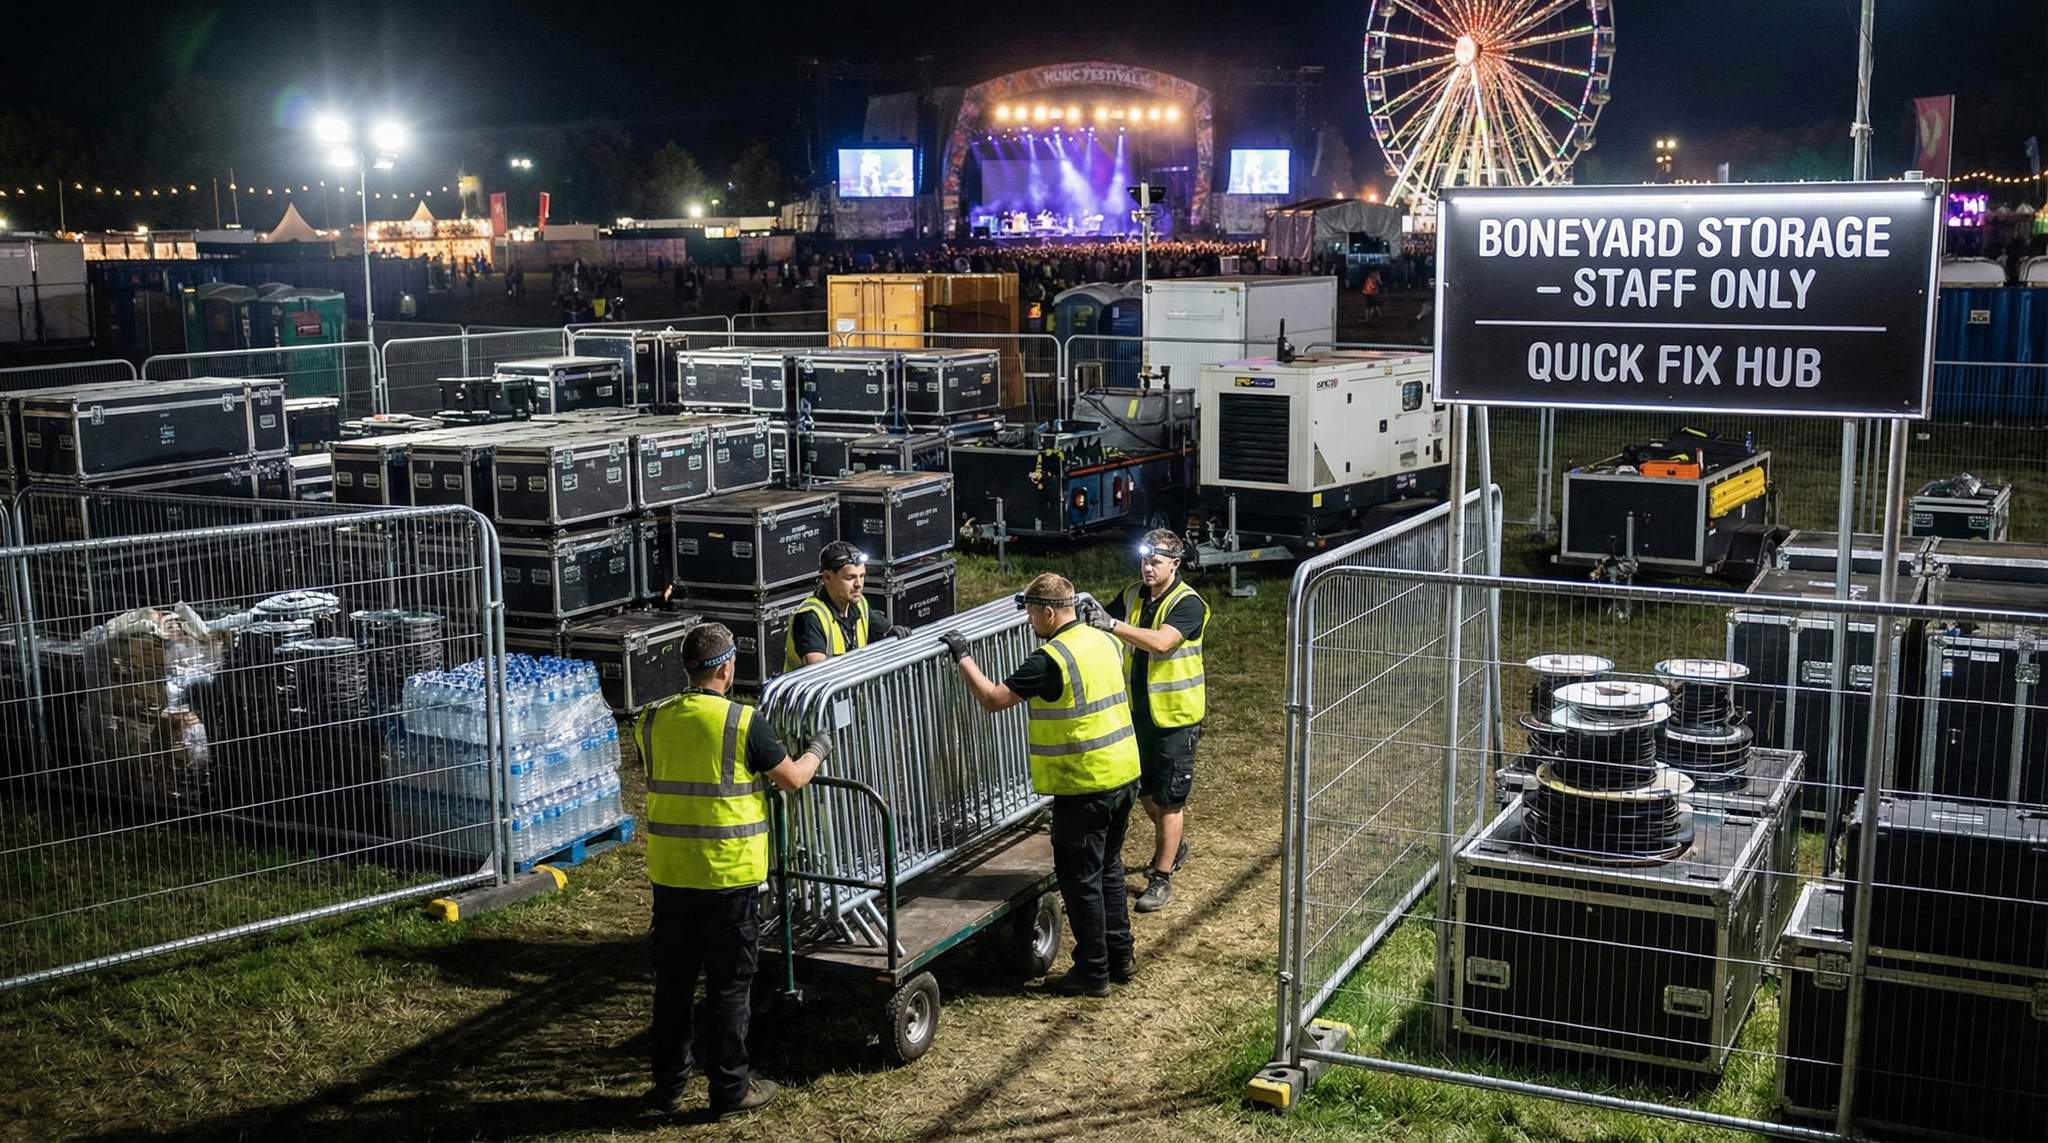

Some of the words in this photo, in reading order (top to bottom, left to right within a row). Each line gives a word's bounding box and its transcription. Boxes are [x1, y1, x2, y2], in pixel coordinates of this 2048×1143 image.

[1085, 66, 1139, 84] FESTIVAL
[1478, 218, 1684, 258] BONEYARD
[1696, 216, 1892, 258] STORAGE
[1536, 286, 1562, 294] –
[1574, 268, 1696, 307] STAFF
[1711, 269, 1816, 309] ONLY
[1528, 342, 1644, 382] QUICK
[1659, 345, 1722, 385] FIX
[1737, 347, 1820, 387] HUB
